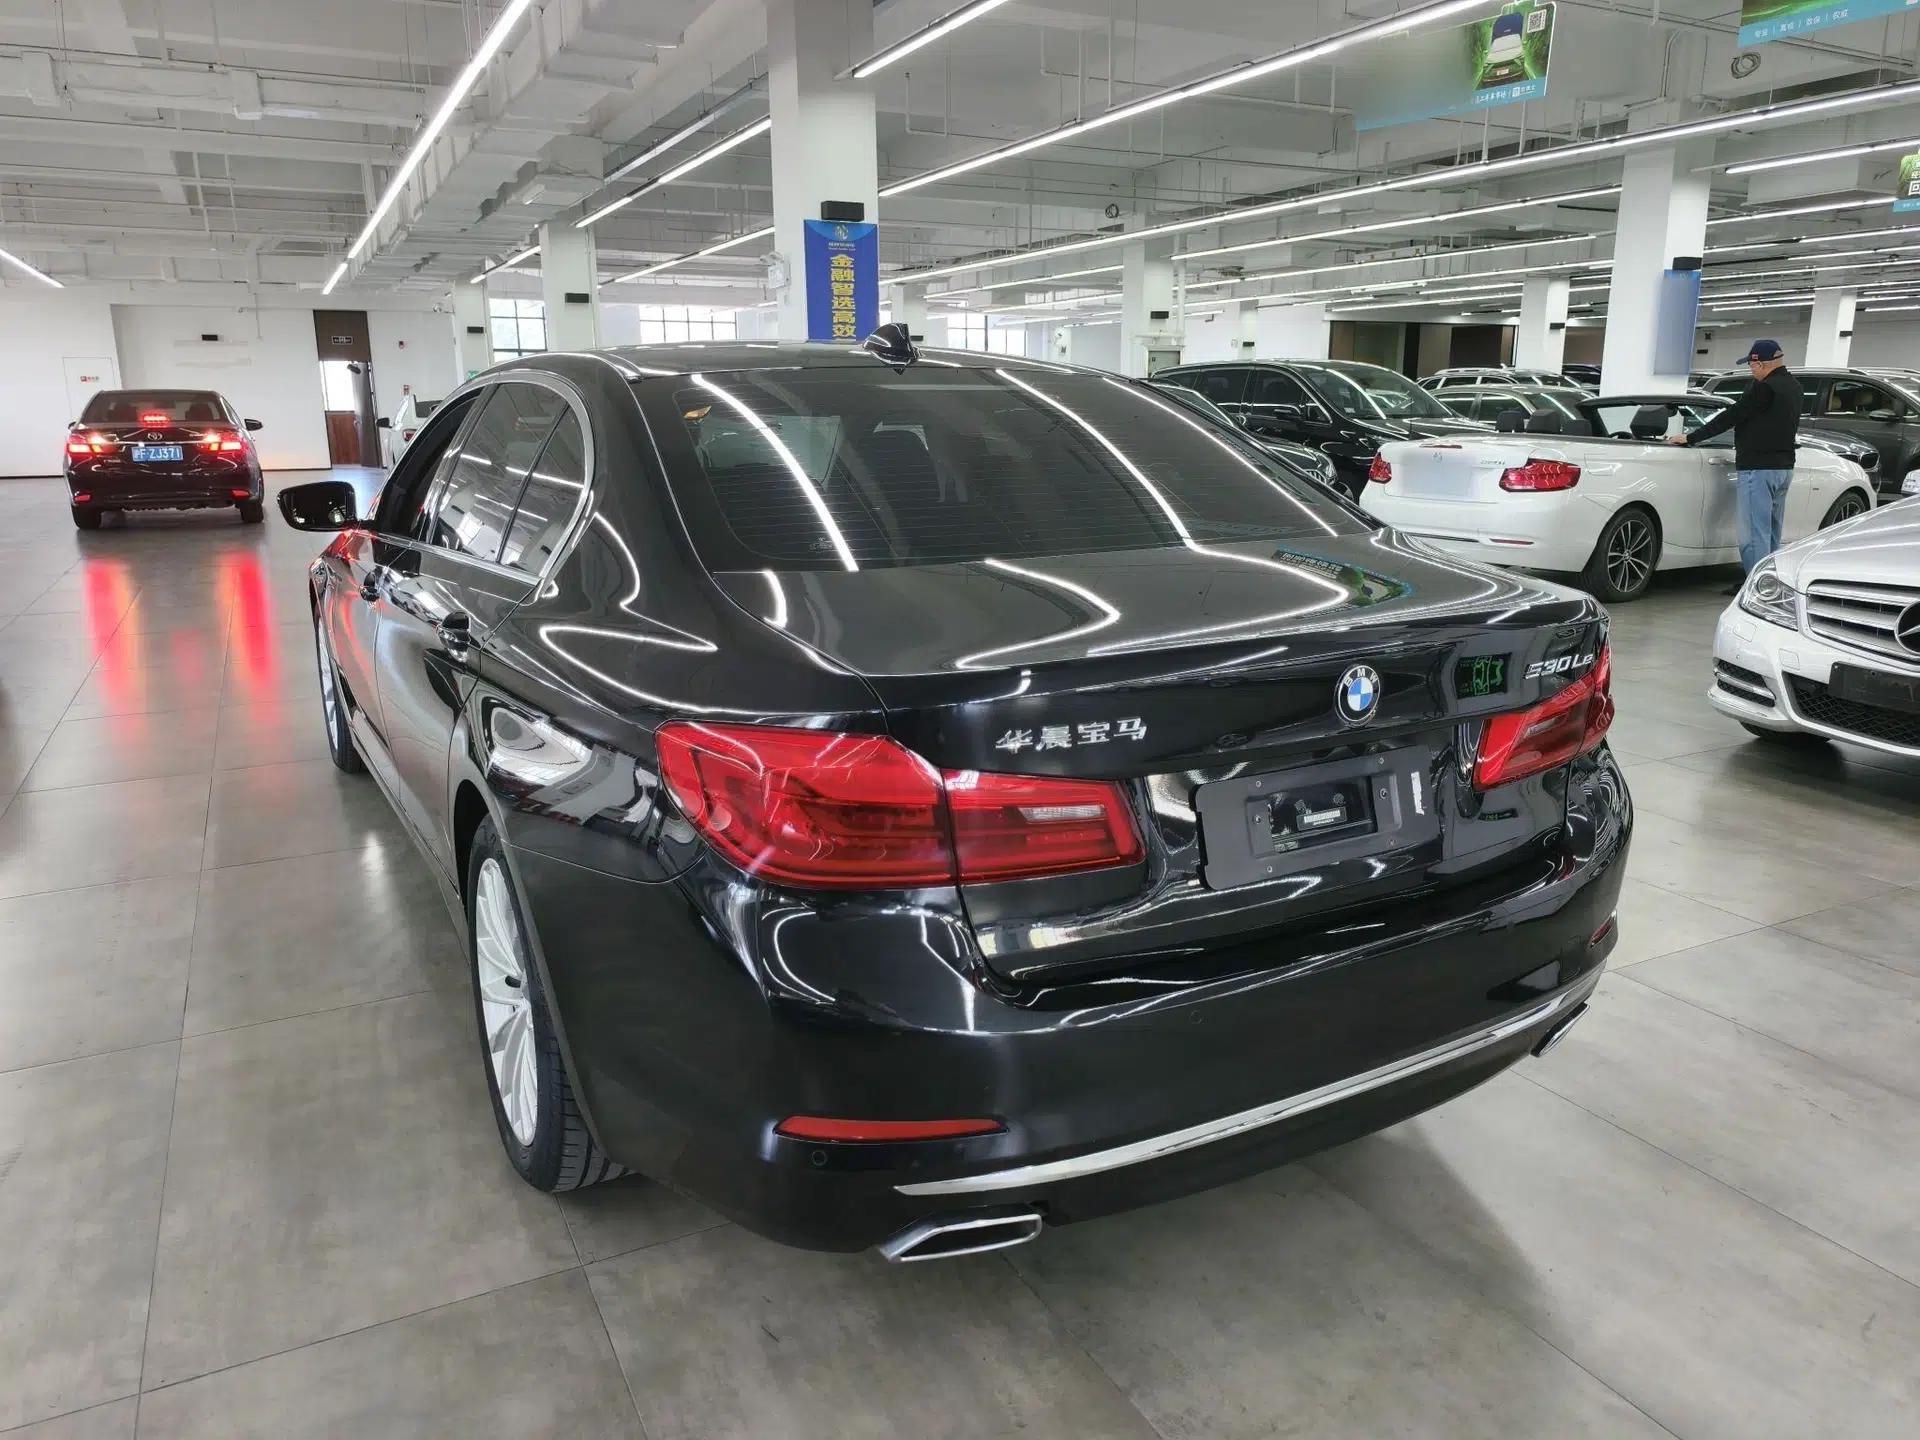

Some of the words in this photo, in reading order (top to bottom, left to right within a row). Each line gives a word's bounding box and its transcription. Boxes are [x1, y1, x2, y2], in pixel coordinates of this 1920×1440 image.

[830, 254, 856, 337] 金融智选高效
[1343, 667, 1379, 688] BMW
[1525, 653, 1594, 679] 530Le
[995, 717, 1148, 754] 华晨宝马
